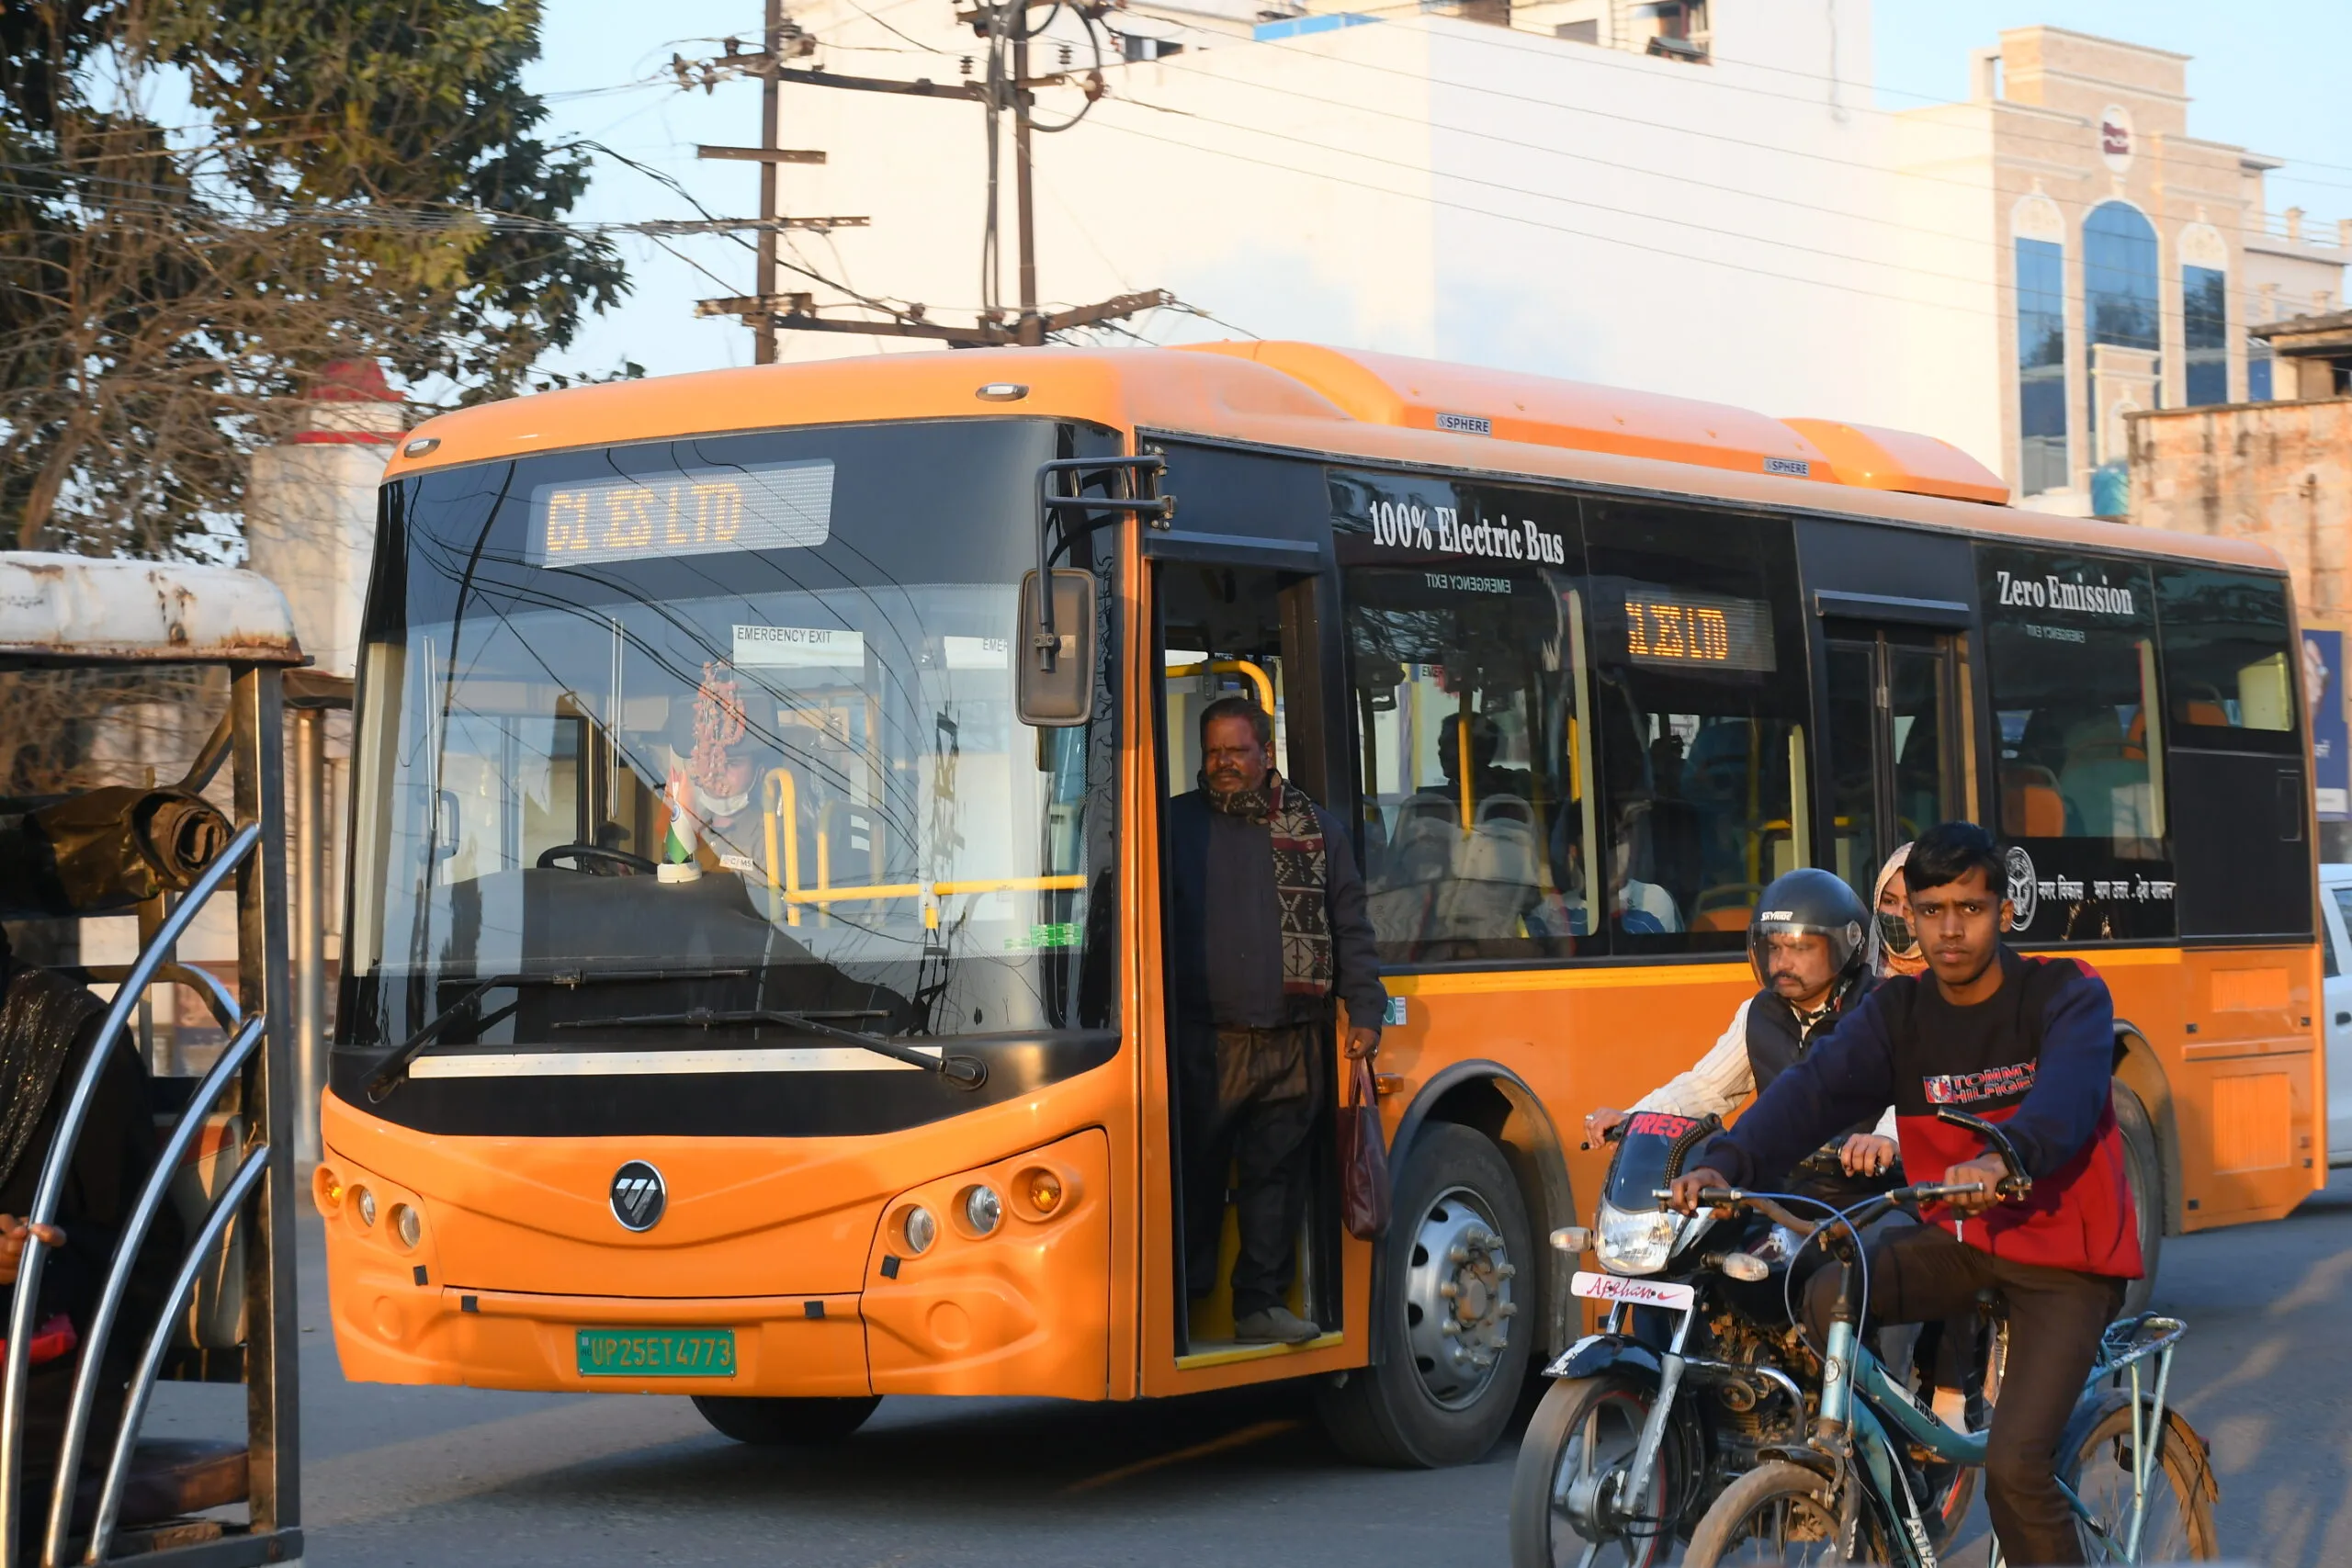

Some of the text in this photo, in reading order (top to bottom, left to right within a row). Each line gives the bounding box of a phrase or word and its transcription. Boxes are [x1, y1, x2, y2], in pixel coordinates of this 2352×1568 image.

[1446, 416, 1489, 433] SPHERE
[1772, 460, 1807, 475] SPHERE
[1369, 500, 1565, 565] 100% Electric Bus
[1996, 570, 2134, 615] Zero Emission
[737, 626, 831, 644] EMERGENCY EXIT
[1951, 1057, 2037, 1091] TOMMY
[1953, 1073, 2037, 1104] HILFIGE
